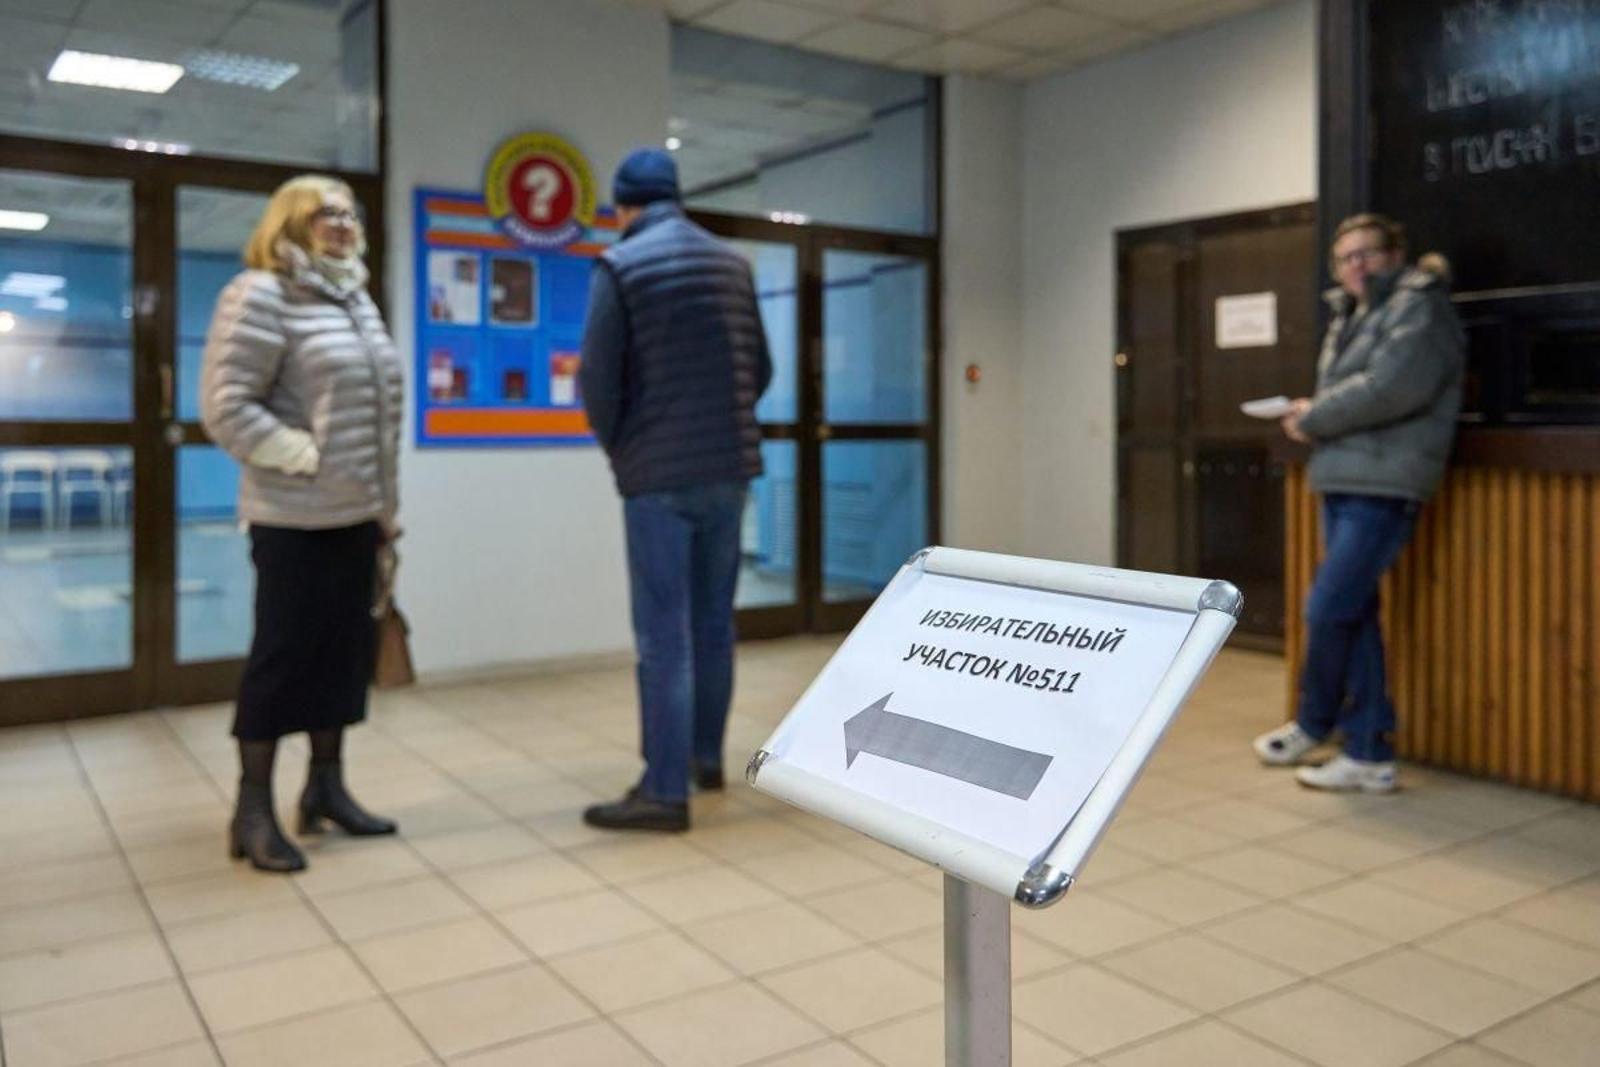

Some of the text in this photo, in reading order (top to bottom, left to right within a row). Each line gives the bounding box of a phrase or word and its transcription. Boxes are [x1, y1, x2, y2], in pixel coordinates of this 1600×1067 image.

[920, 609, 1127, 653] ИЗБИРАТЕЛЬНЫЙ
[903, 643, 1081, 693] УЧАСТОК №511
